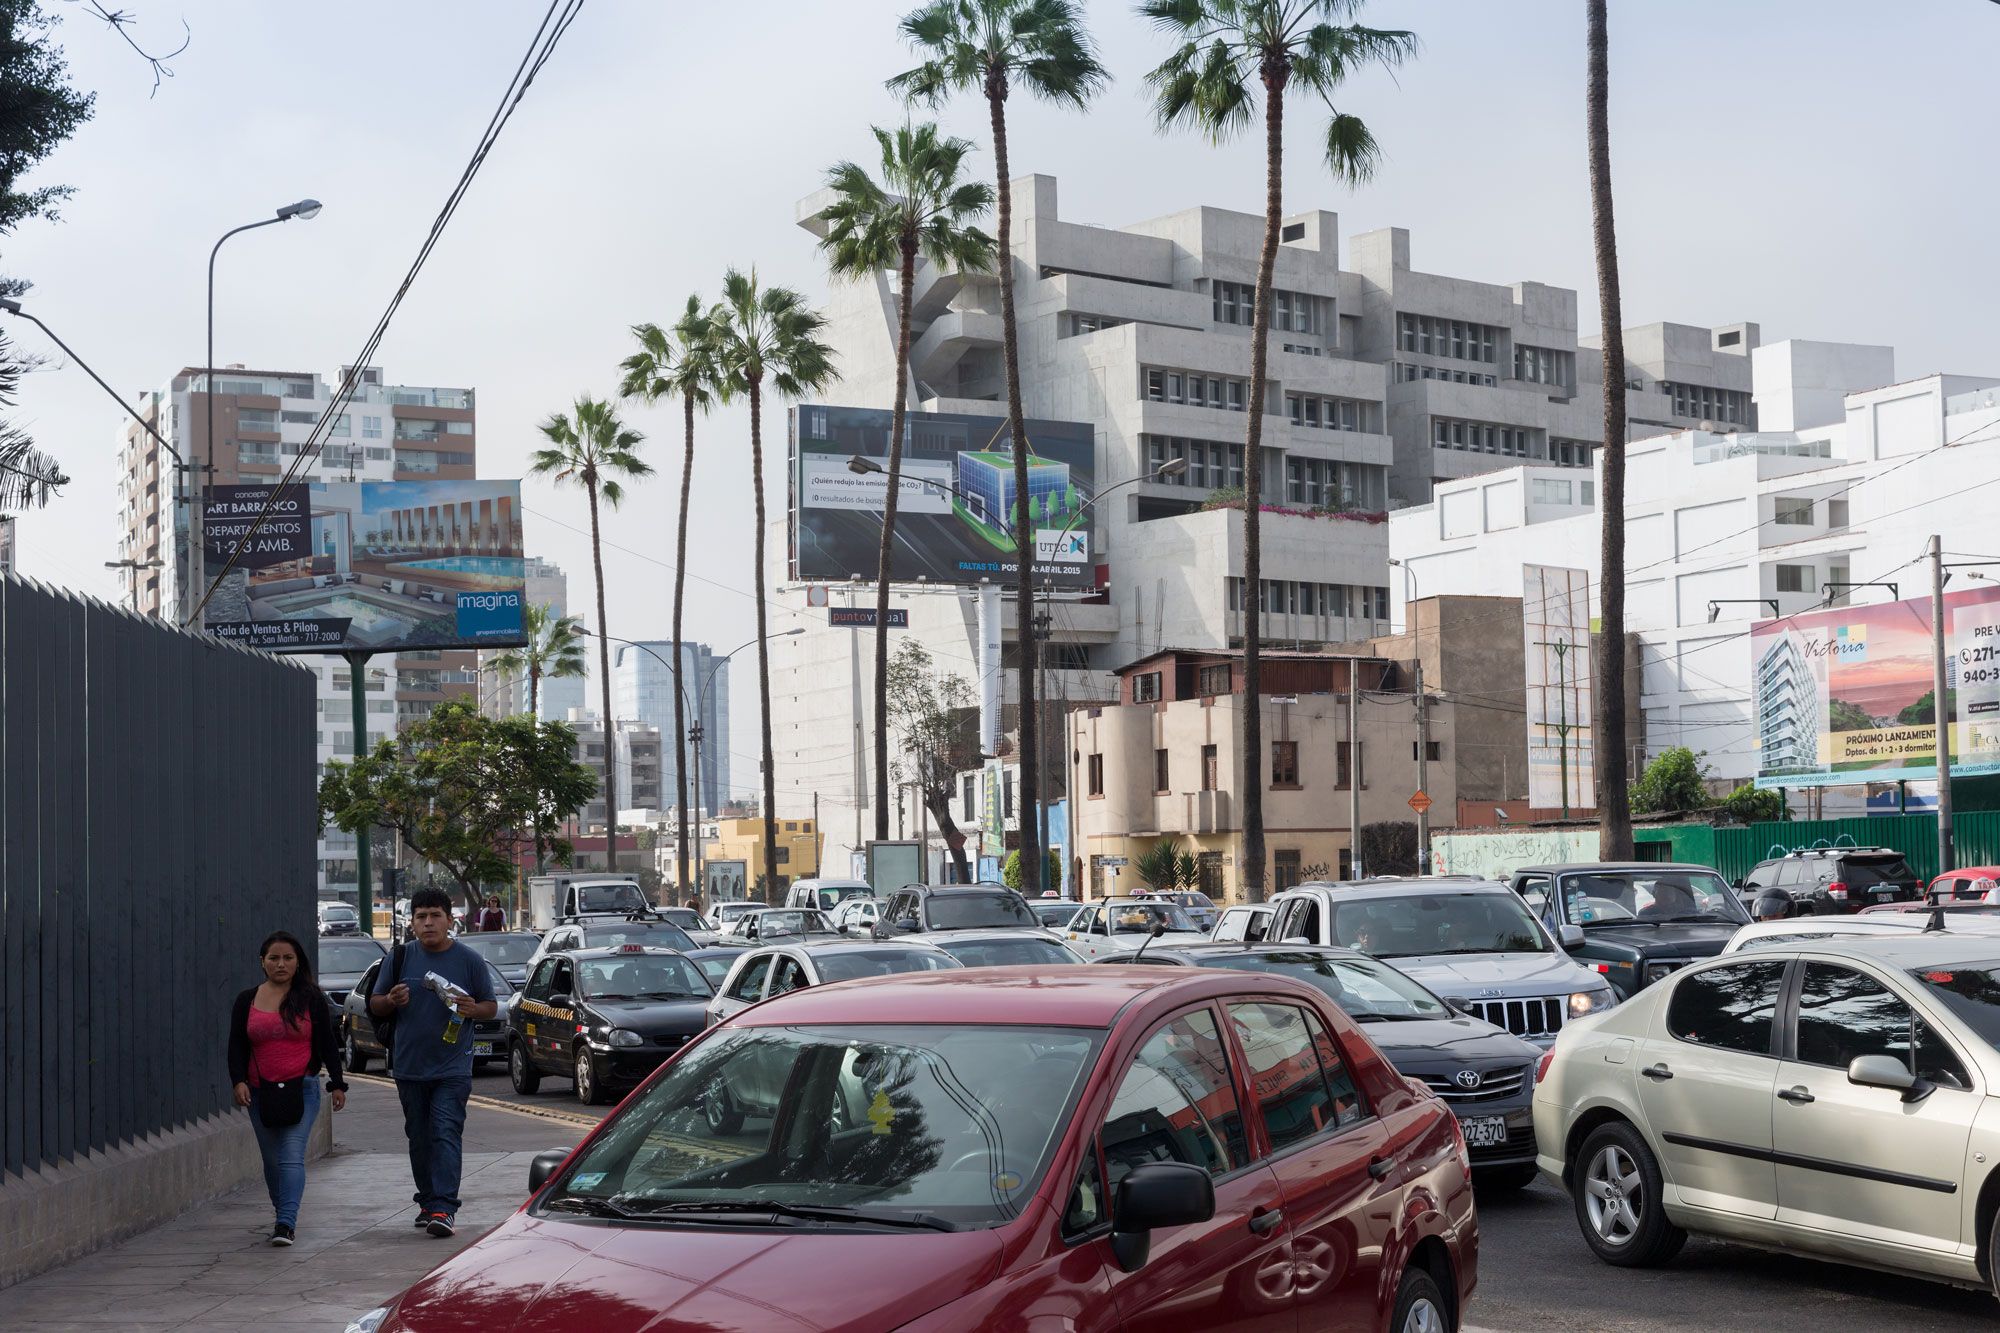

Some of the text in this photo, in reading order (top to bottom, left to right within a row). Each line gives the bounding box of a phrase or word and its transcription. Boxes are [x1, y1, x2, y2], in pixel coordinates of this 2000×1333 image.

[811, 477, 833, 486] ¿Quién
[834, 479, 855, 488] redujo
[234, 491, 269, 499] concepto
[820, 495, 854, 504] resultados
[207, 500, 298, 514] ART BARRANCO
[206, 523, 300, 536] DEPARTAMENTOS
[256, 538, 294, 552] AMB.
[1040, 542, 1068, 552] UTEC
[959, 562, 986, 571] FALTAS
[988, 561, 1000, 572] TÚ.
[1040, 565, 1062, 574] ABRIL
[1063, 565, 1081, 575] 2015
[457, 592, 519, 611] imagina
[216, 624, 237, 636] Sala
[239, 623, 250, 635] de
[251, 622, 281, 634] Ventas
[283, 622, 291, 633] &
[293, 620, 319, 633] Piloto
[1974, 625, 1993, 638] PRE
[250, 635, 260, 645] Av.
[262, 633, 275, 644] San
[277, 632, 299, 643] Martín
[305, 631, 341, 642] 717-2000
[1803, 638, 1865, 658] Victoria
[1973, 645, 2000, 662] 271-
[1963, 667, 2000, 683] 940-3
[1846, 729, 1937, 745] PRÓXIMO LANZAMIENT
[1845, 748, 1868, 758] Dptos.
[1869, 746, 1878, 755] de
[1977, 881, 1997, 889] TAXI
[623, 944, 641, 953] TAXI
[1480, 988, 1505, 998] Jeep
